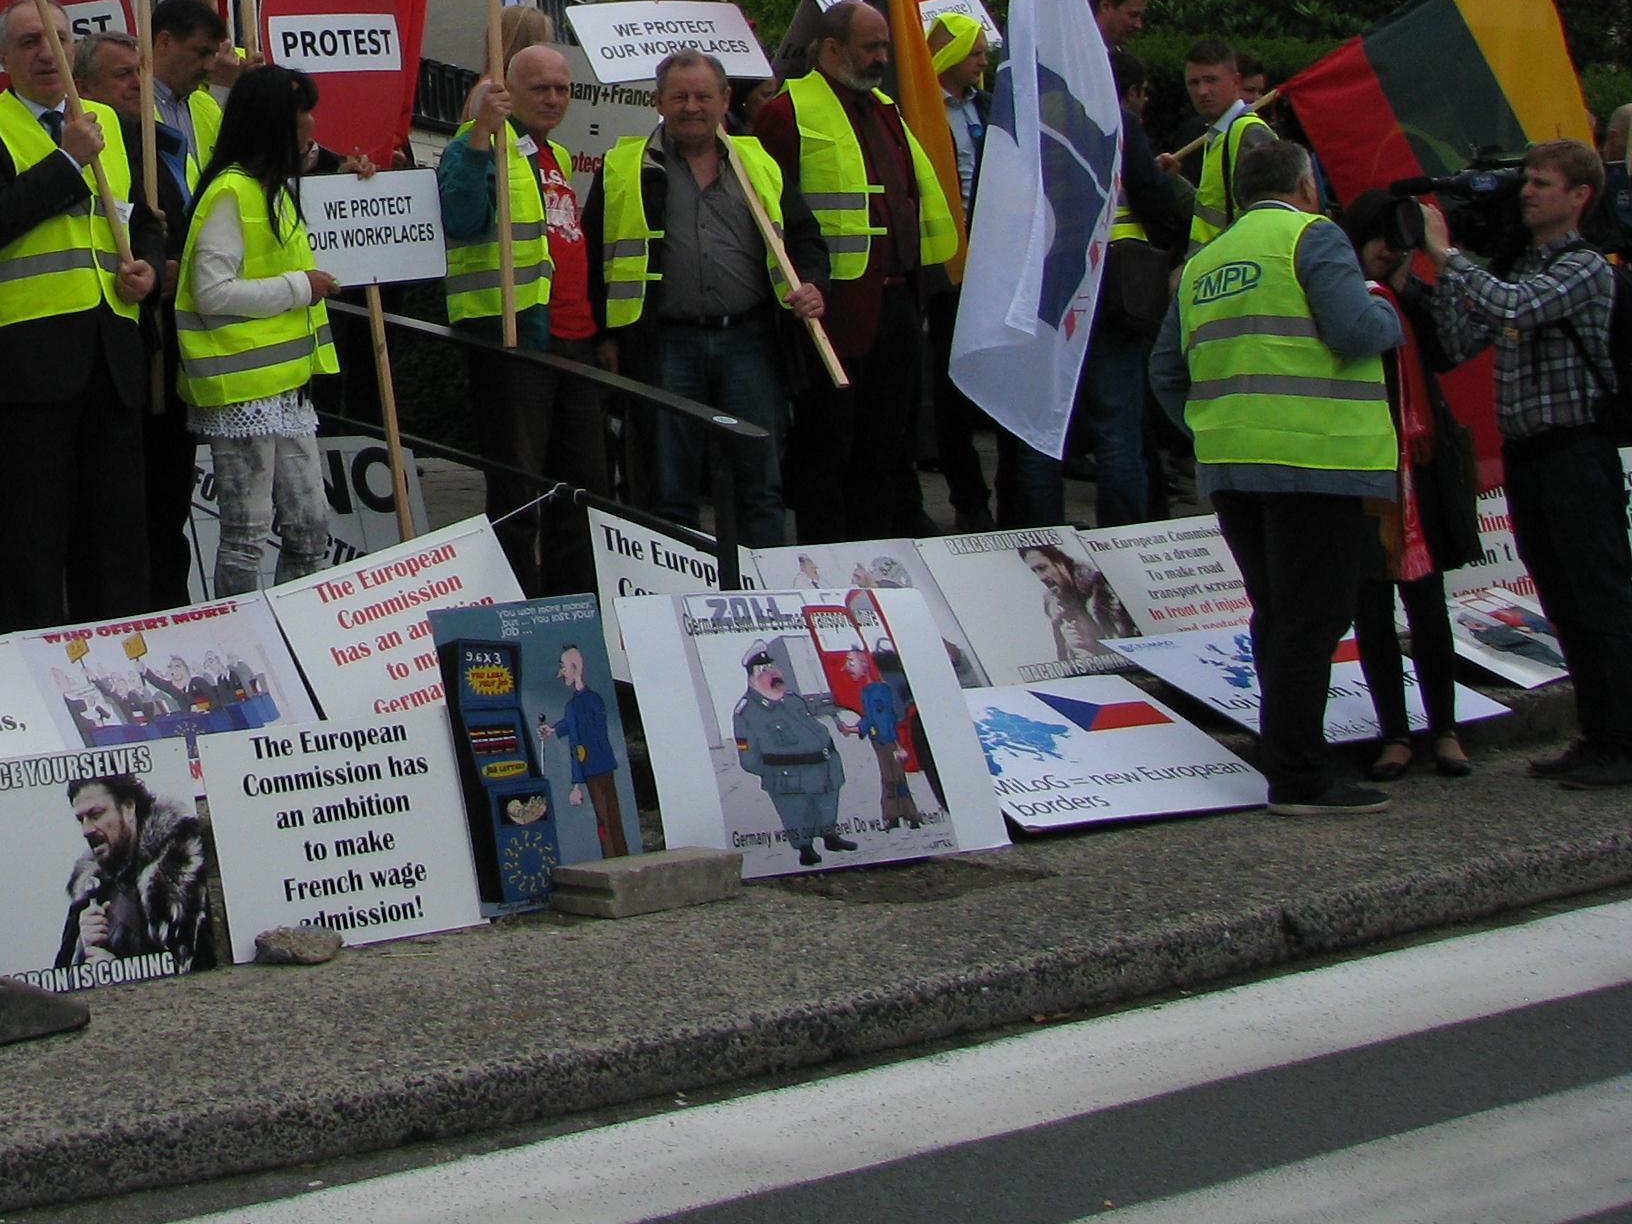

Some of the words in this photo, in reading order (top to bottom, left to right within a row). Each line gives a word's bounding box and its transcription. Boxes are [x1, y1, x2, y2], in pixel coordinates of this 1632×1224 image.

[282, 28, 392, 58] PROTEST
[612, 20, 641, 37] WE
[644, 19, 716, 36] PROTECT
[600, 41, 638, 61] OUR
[642, 39, 750, 59] WORKPLACES
[324, 201, 348, 220] WE
[352, 196, 412, 217] PROTECT
[308, 232, 338, 252] OUR
[341, 223, 434, 248] WORKPLACES
[600, 524, 644, 560] The
[1088, 539, 1112, 553] The
[1113, 534, 1167, 550] European
[1138, 552, 1163, 564] has
[1173, 546, 1210, 560] dream
[313, 580, 354, 606] The
[357, 543, 457, 592] European
[1146, 569, 1164, 582] To
[1167, 565, 1196, 579] make
[1198, 561, 1224, 574] road
[337, 572, 464, 630] Commission
[1147, 584, 1202, 600] transport
[1168, 603, 1199, 619] front
[1200, 601, 1214, 614] of
[96, 615, 168, 637] OFFERS
[331, 642, 371, 667] has
[376, 632, 404, 654] an
[386, 659, 410, 680] to
[250, 734, 294, 760] The
[299, 722, 407, 757] European
[22, 745, 152, 787] YOURSELVES
[242, 763, 382, 798] Commission
[388, 756, 429, 779] has
[995, 773, 1070, 796] MiLoG
[1089, 769, 1143, 788] new
[1142, 760, 1248, 784] European
[275, 807, 307, 829] an
[311, 792, 411, 825] ambition
[1016, 790, 1110, 817] borders
[303, 839, 330, 862] to
[334, 830, 396, 858] make
[283, 868, 364, 903] French
[370, 863, 427, 893] wage
[69, 962, 94, 990] IS
[97, 951, 175, 986] COMING
